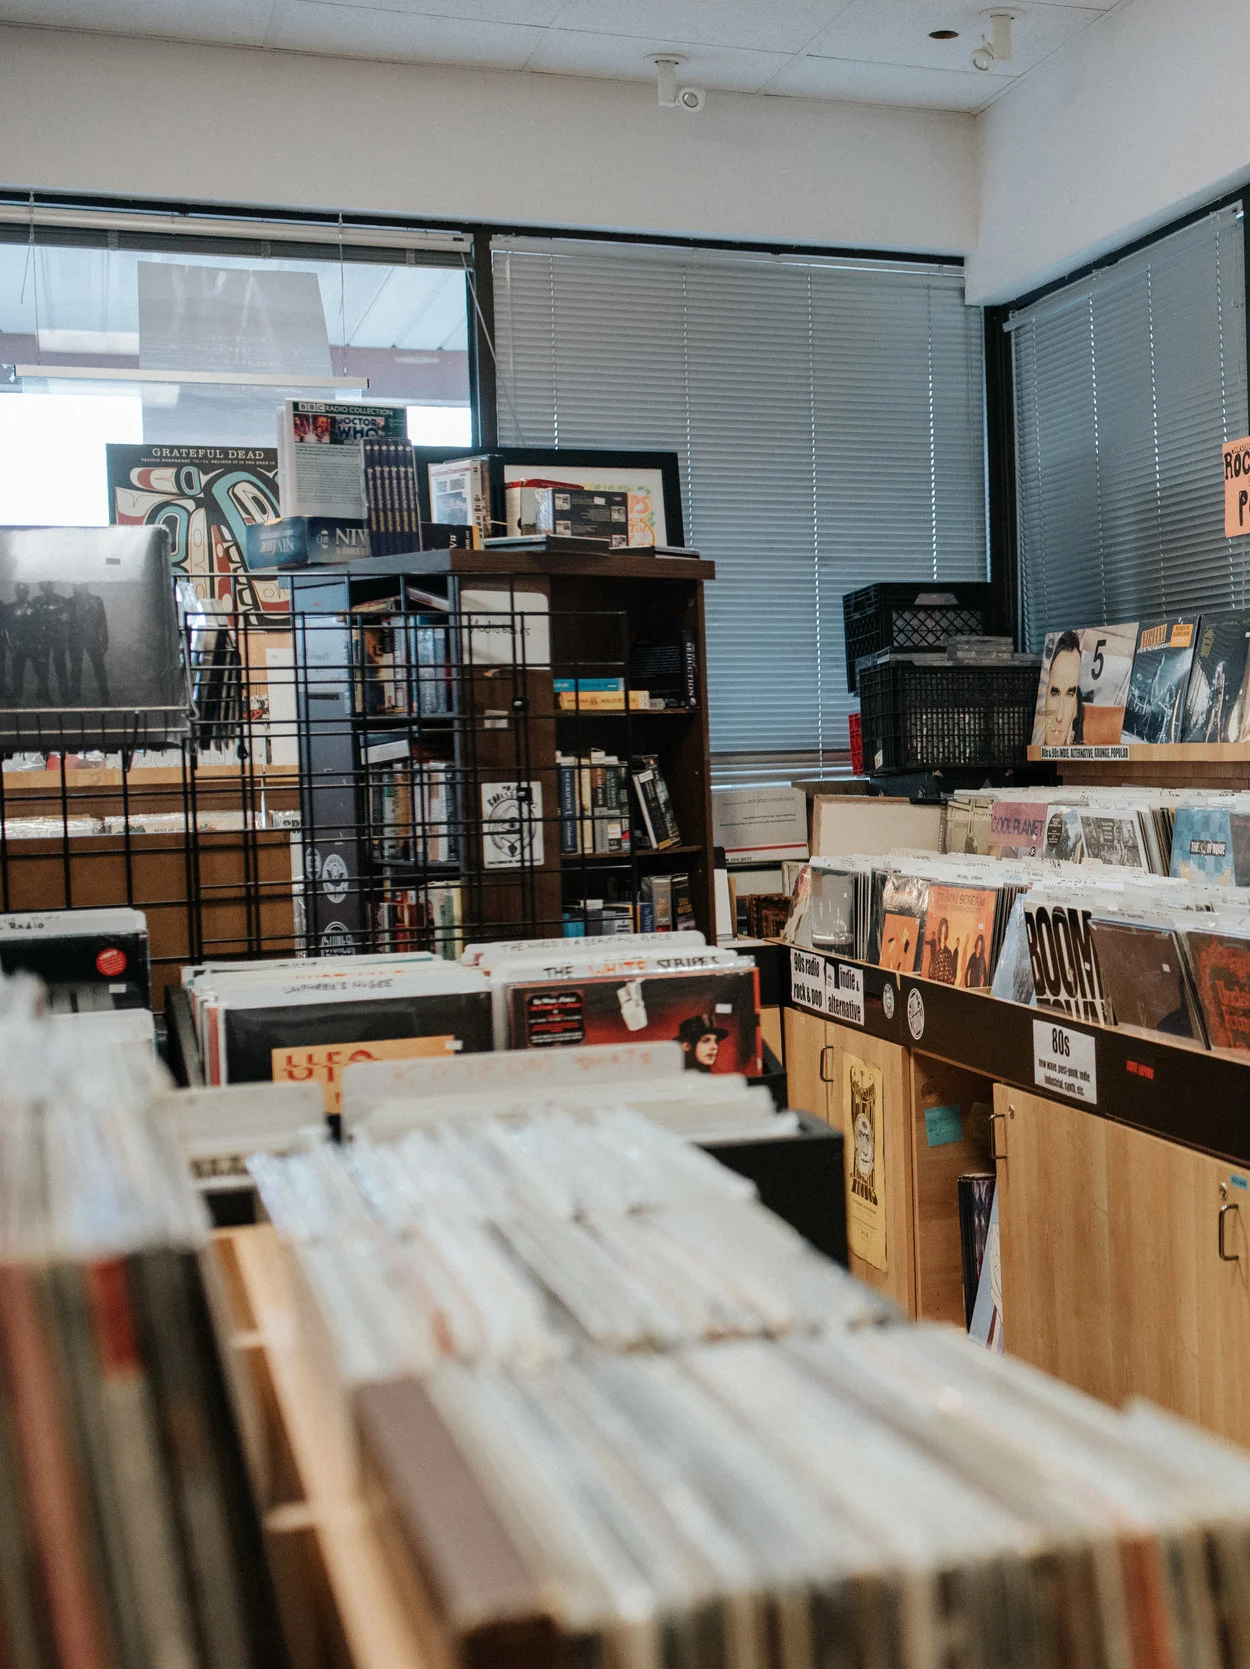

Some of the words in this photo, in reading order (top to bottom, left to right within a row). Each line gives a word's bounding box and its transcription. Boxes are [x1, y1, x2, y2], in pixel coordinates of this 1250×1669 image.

[299, 402, 325, 412] BBC
[325, 403, 348, 413] RADIO
[349, 405, 393, 415] COLLECTION
[337, 417, 377, 427] DOCTOR
[338, 426, 379, 440] WHO
[152, 447, 224, 459] GRATEFUL
[228, 449, 264, 459] DEAD
[1091, 639, 1107, 680] 5
[1111, 748, 1129, 758] POPULAR
[1012, 818, 1046, 837] PLANET
[960, 894, 986, 907] SCREAM
[501, 942, 527, 953] THE
[544, 966, 574, 980] THE
[587, 960, 648, 976] WHITE
[656, 955, 720, 969] STRIPES
[794, 952, 804, 973] 90s
[805, 957, 820, 978] radio
[840, 967, 855, 991] indie
[856, 980, 860, 992] &
[794, 982, 806, 1002] rock
[807, 987, 811, 1002] &
[811, 988, 823, 1008] pop
[828, 994, 861, 1022] alternative
[1052, 1028, 1070, 1057] 80s
